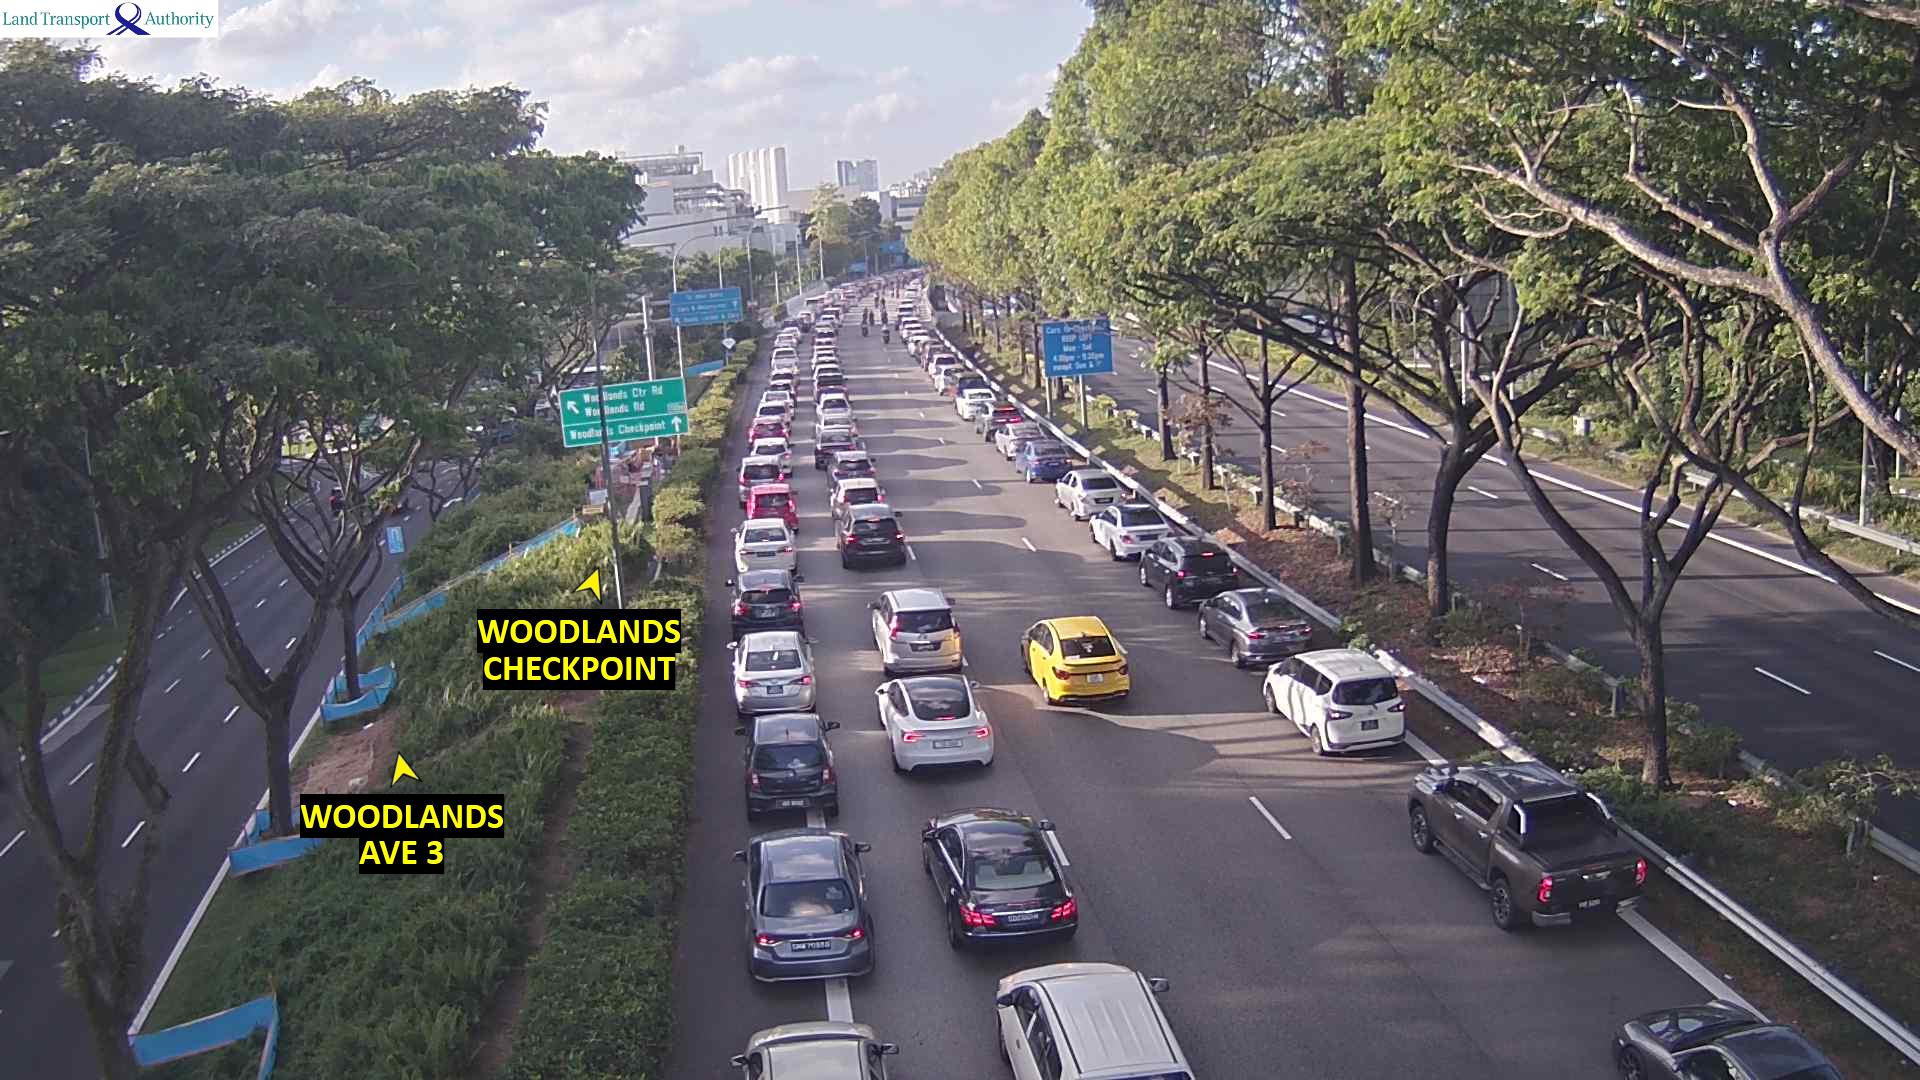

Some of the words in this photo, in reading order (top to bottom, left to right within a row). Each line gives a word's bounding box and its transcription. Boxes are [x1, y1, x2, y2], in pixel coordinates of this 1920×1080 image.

[632, 387, 647, 398] Ctr
[651, 385, 663, 396] Rd
[633, 401, 645, 412] Rd
[618, 420, 666, 434] Checkpoint
